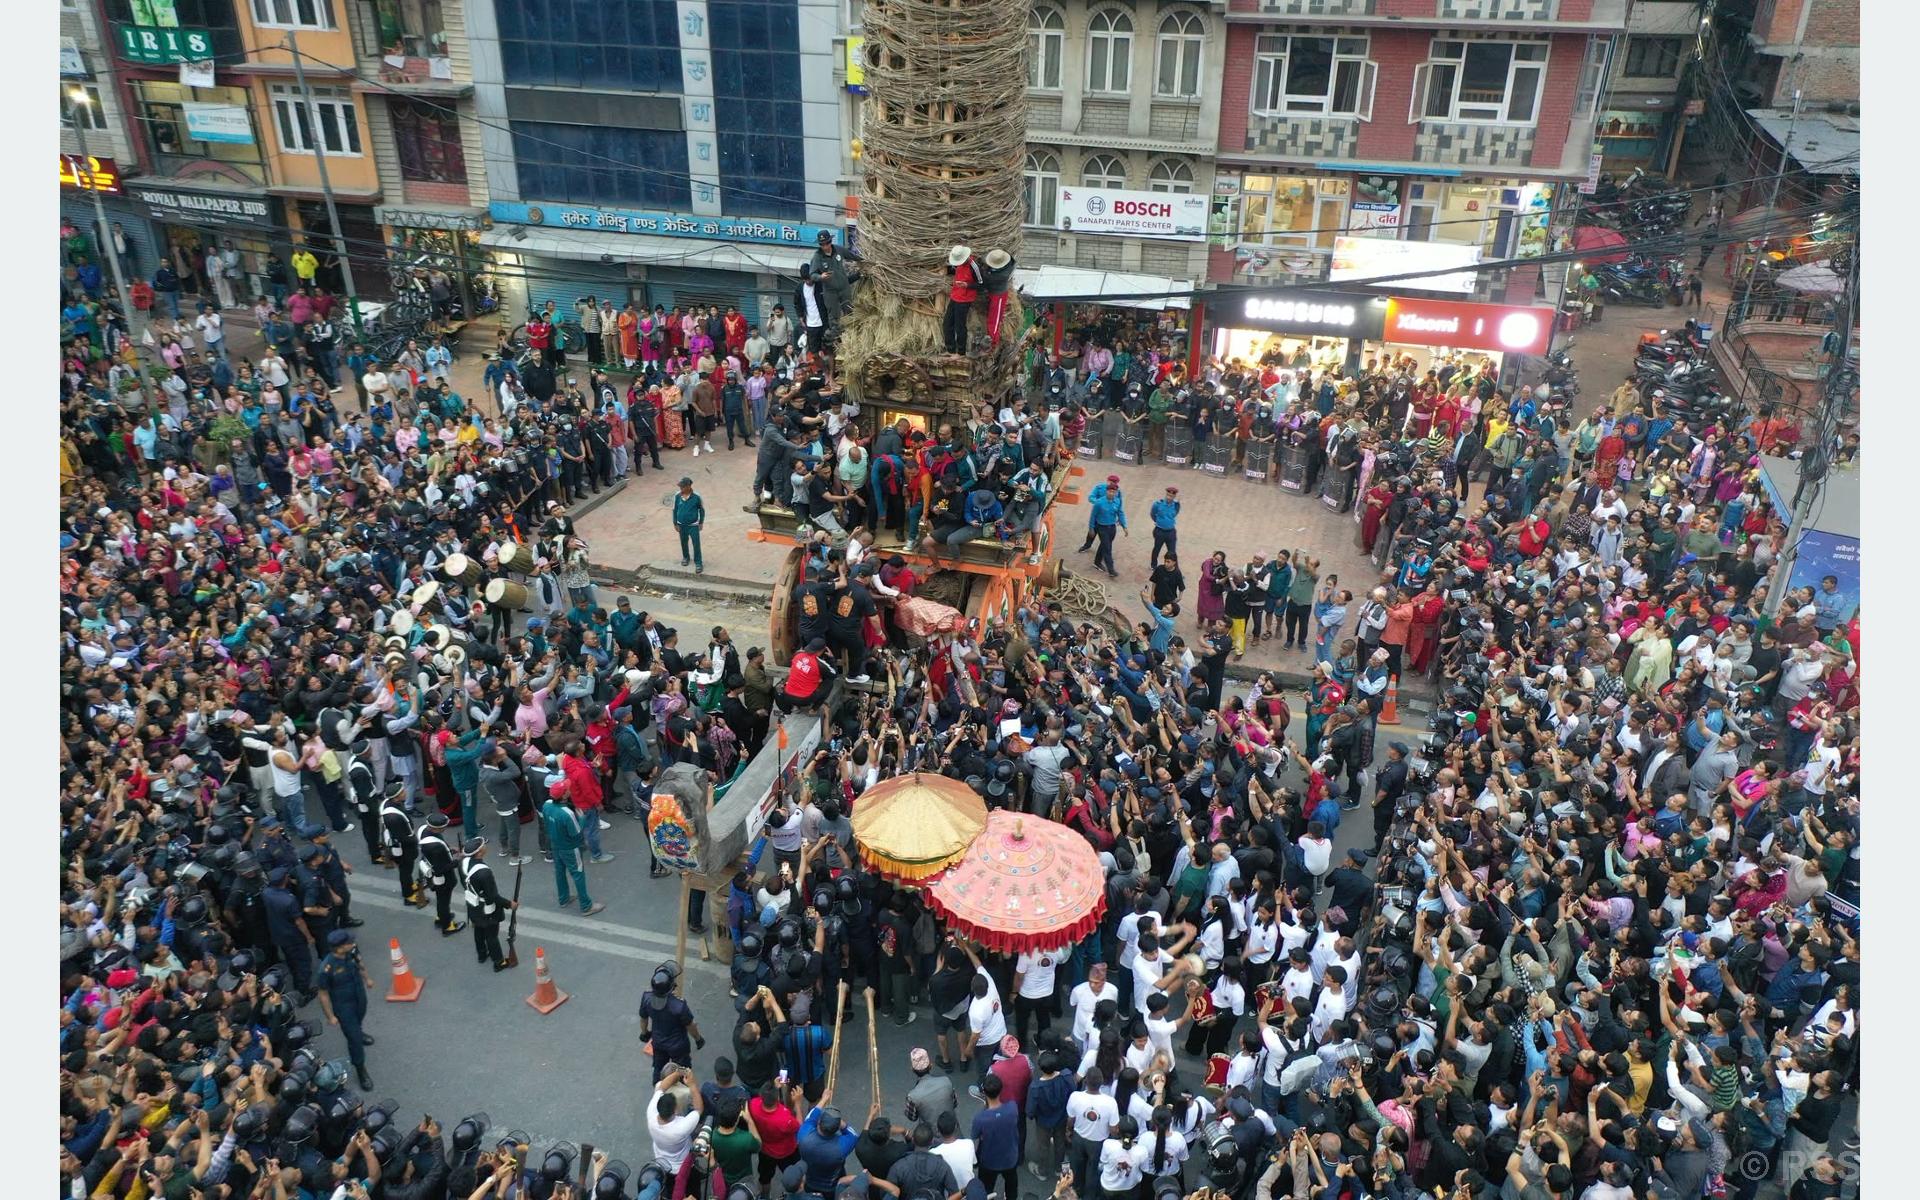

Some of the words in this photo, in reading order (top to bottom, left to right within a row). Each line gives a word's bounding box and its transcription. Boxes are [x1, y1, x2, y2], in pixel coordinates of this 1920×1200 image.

[125, 30, 206, 52] IRIS
[141, 192, 179, 207] ROYAL
[177, 195, 242, 213] WALLPAPER
[241, 201, 267, 216] HUB
[1114, 200, 1171, 217] BOSCH
[1078, 217, 1115, 226] GANAPATI
[1115, 220, 1140, 228] PARTS
[1142, 221, 1172, 230] CENTER
[1245, 298, 1356, 326] SAMSUNG
[1397, 312, 1459, 333] Xiaomi
